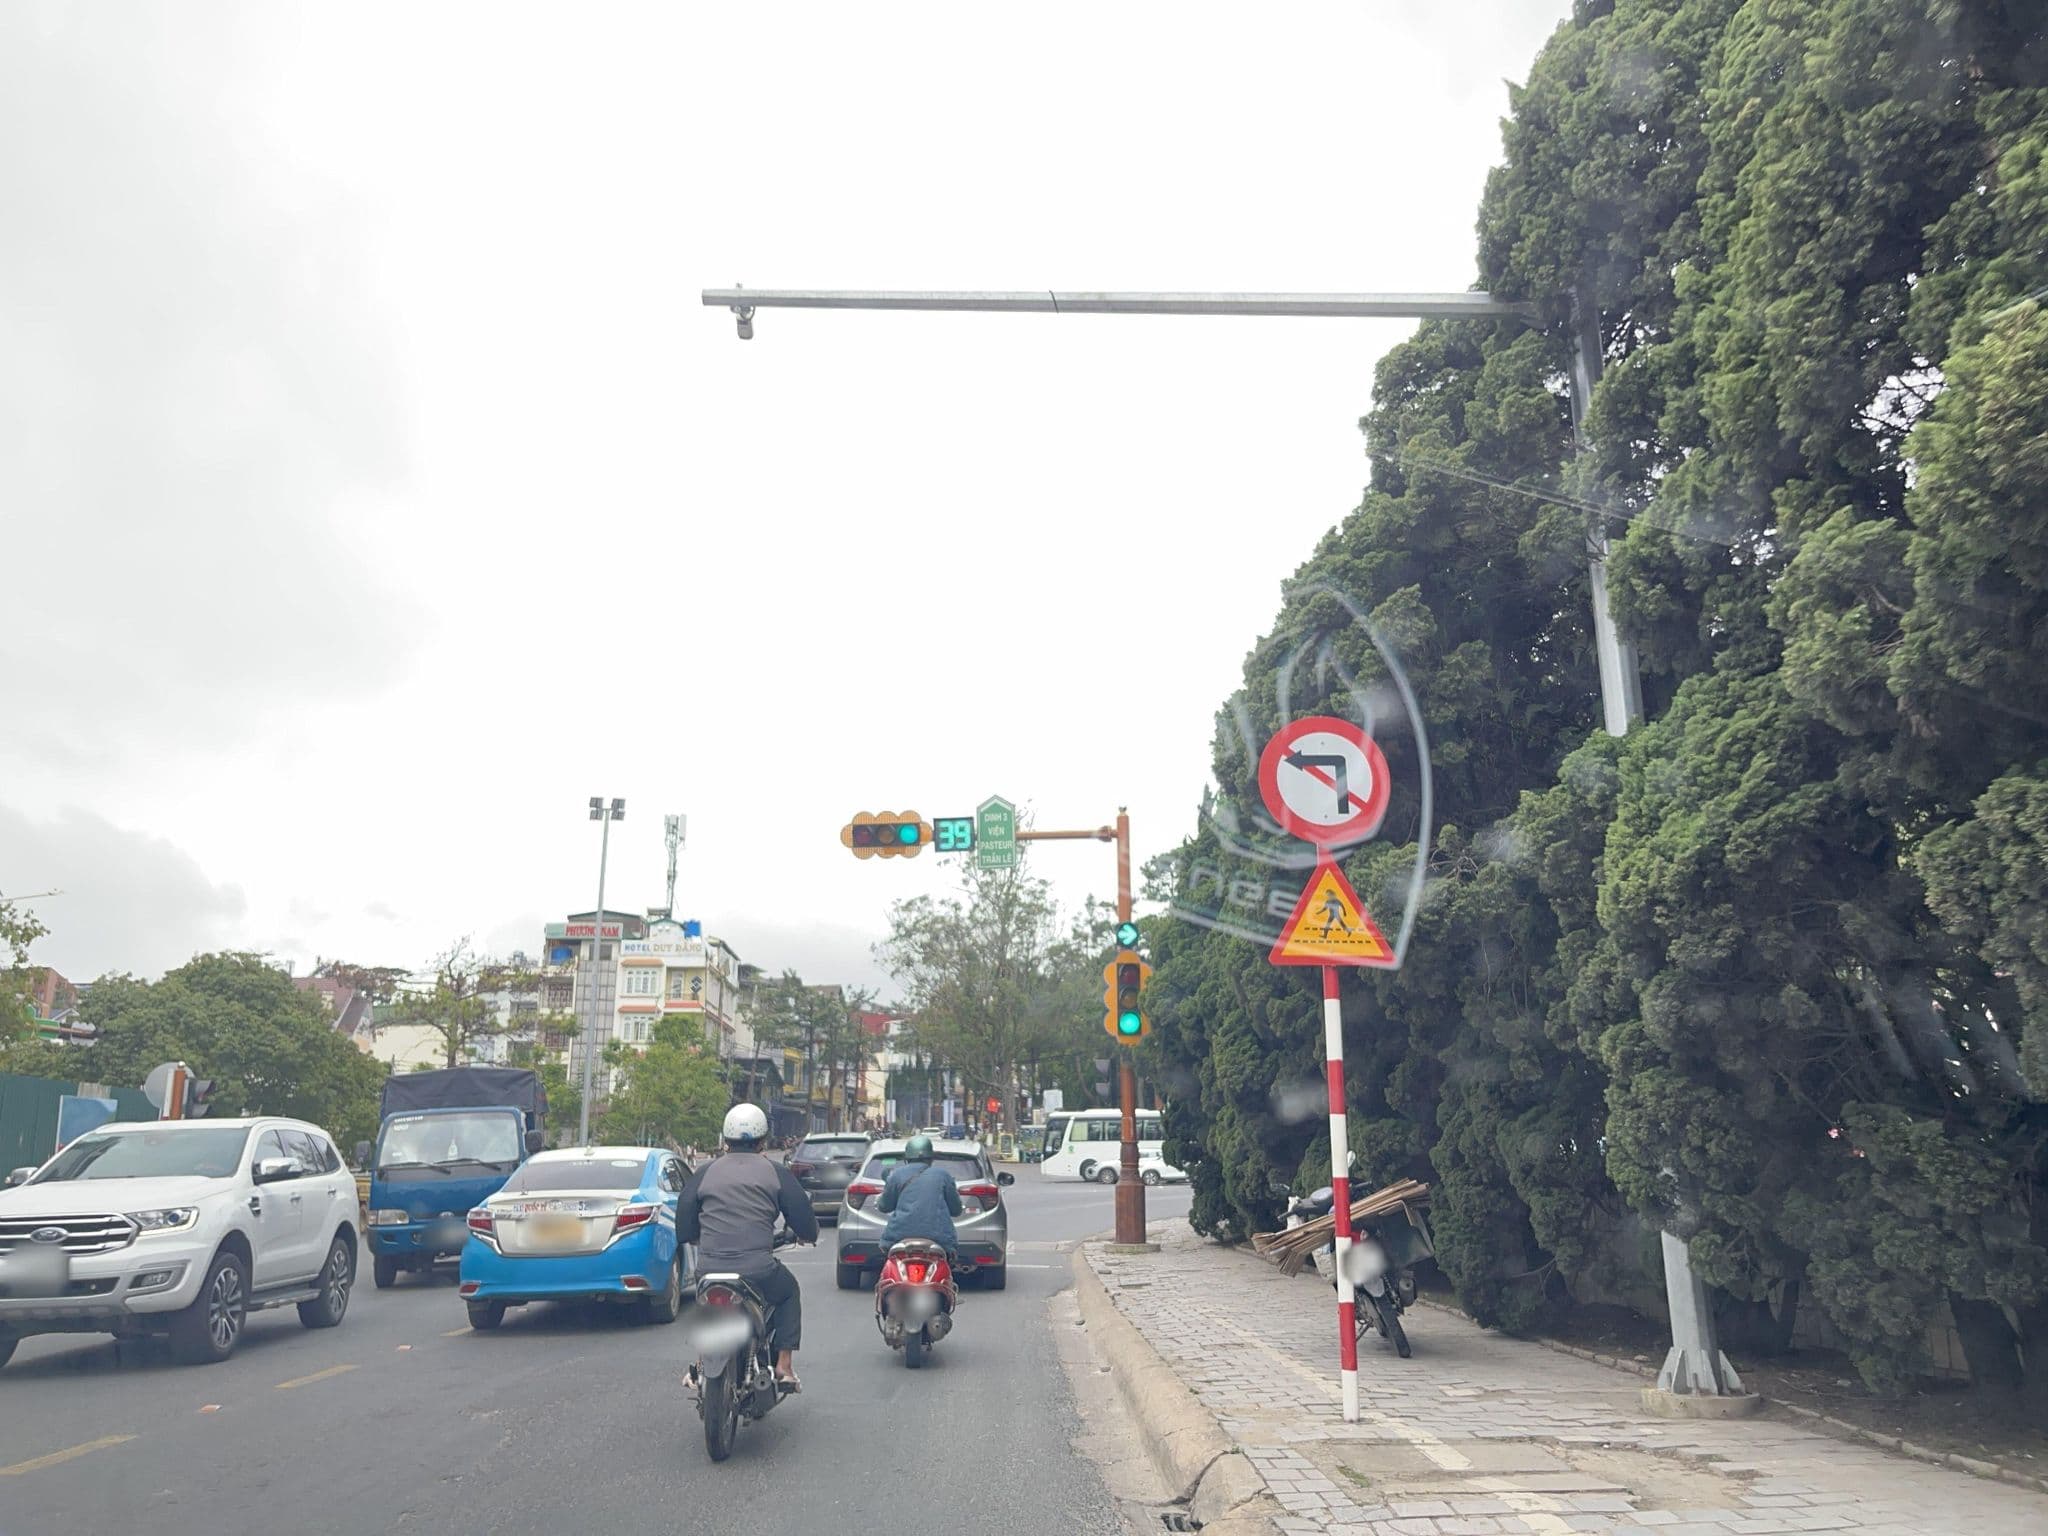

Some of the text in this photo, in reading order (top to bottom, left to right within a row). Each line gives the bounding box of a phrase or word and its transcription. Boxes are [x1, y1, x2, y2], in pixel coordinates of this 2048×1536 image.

[939, 820, 970, 849] 39
[980, 840, 1013, 850] PASTEUR
[565, 926, 620, 937] PHƯƠN NAM
[624, 943, 650, 952] HOTEL
